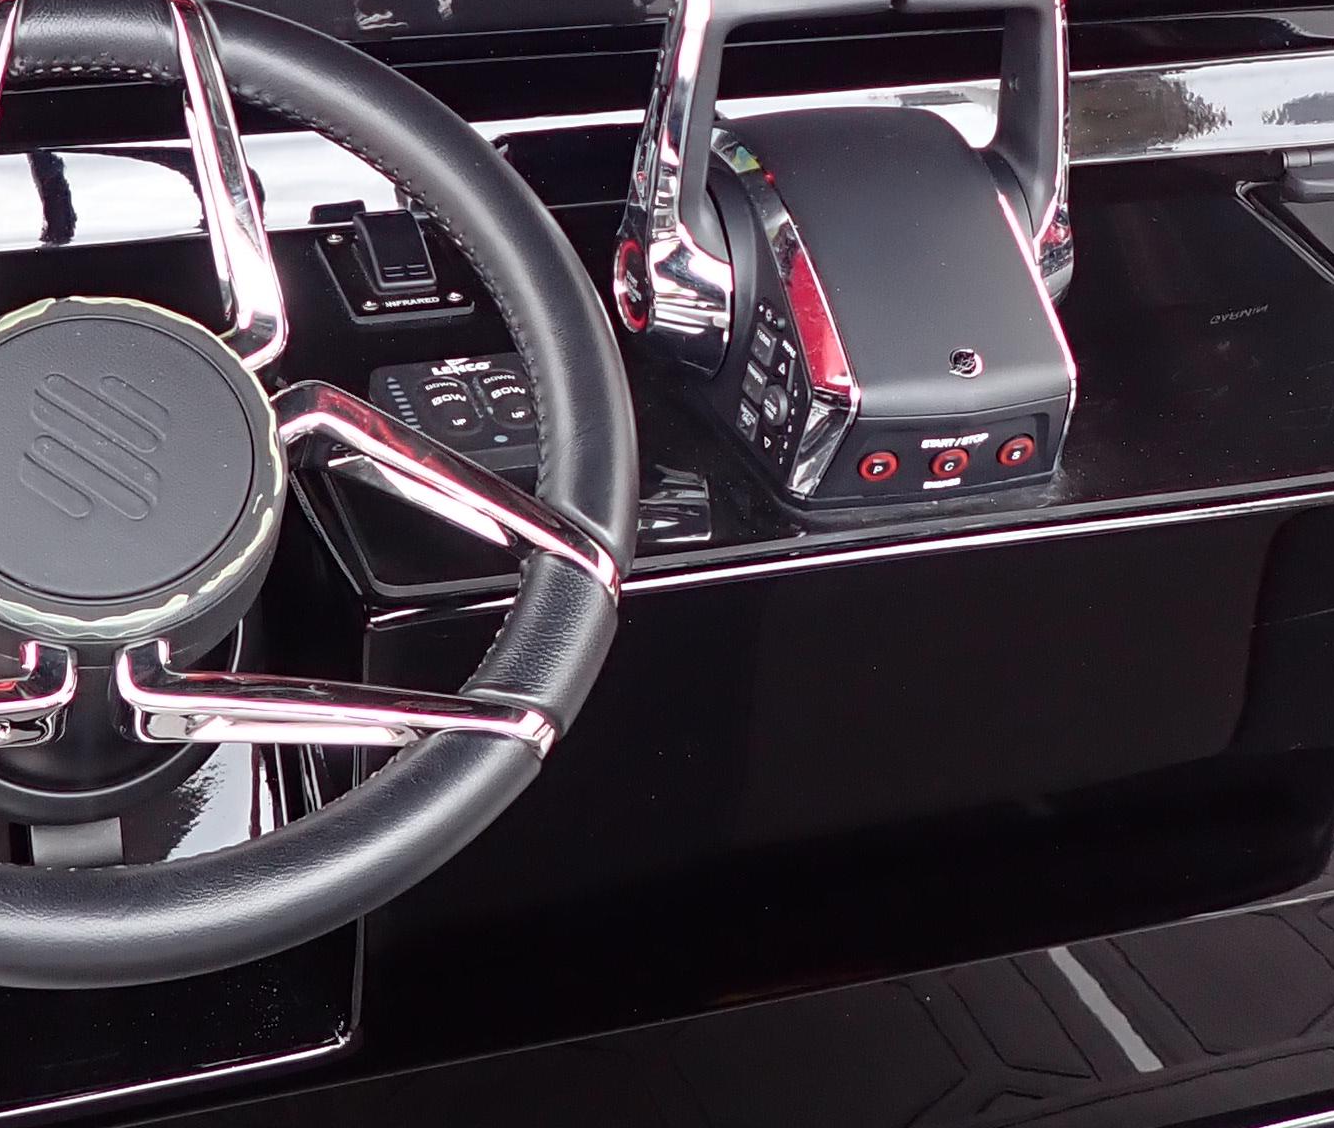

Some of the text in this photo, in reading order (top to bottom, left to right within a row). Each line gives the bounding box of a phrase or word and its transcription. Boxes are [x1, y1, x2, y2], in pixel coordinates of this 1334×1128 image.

[385, 296, 440, 308] INFRARED
[431, 360, 490, 375] LENCO
[483, 374, 515, 384] DOWN
[491, 386, 526, 400] BOW
[431, 393, 467, 407] BOW
[511, 410, 526, 419] UP
[452, 418, 467, 426] UP
[1011, 451, 1021, 461] S
[872, 465, 884, 475] P
[944, 462, 955, 472] C
